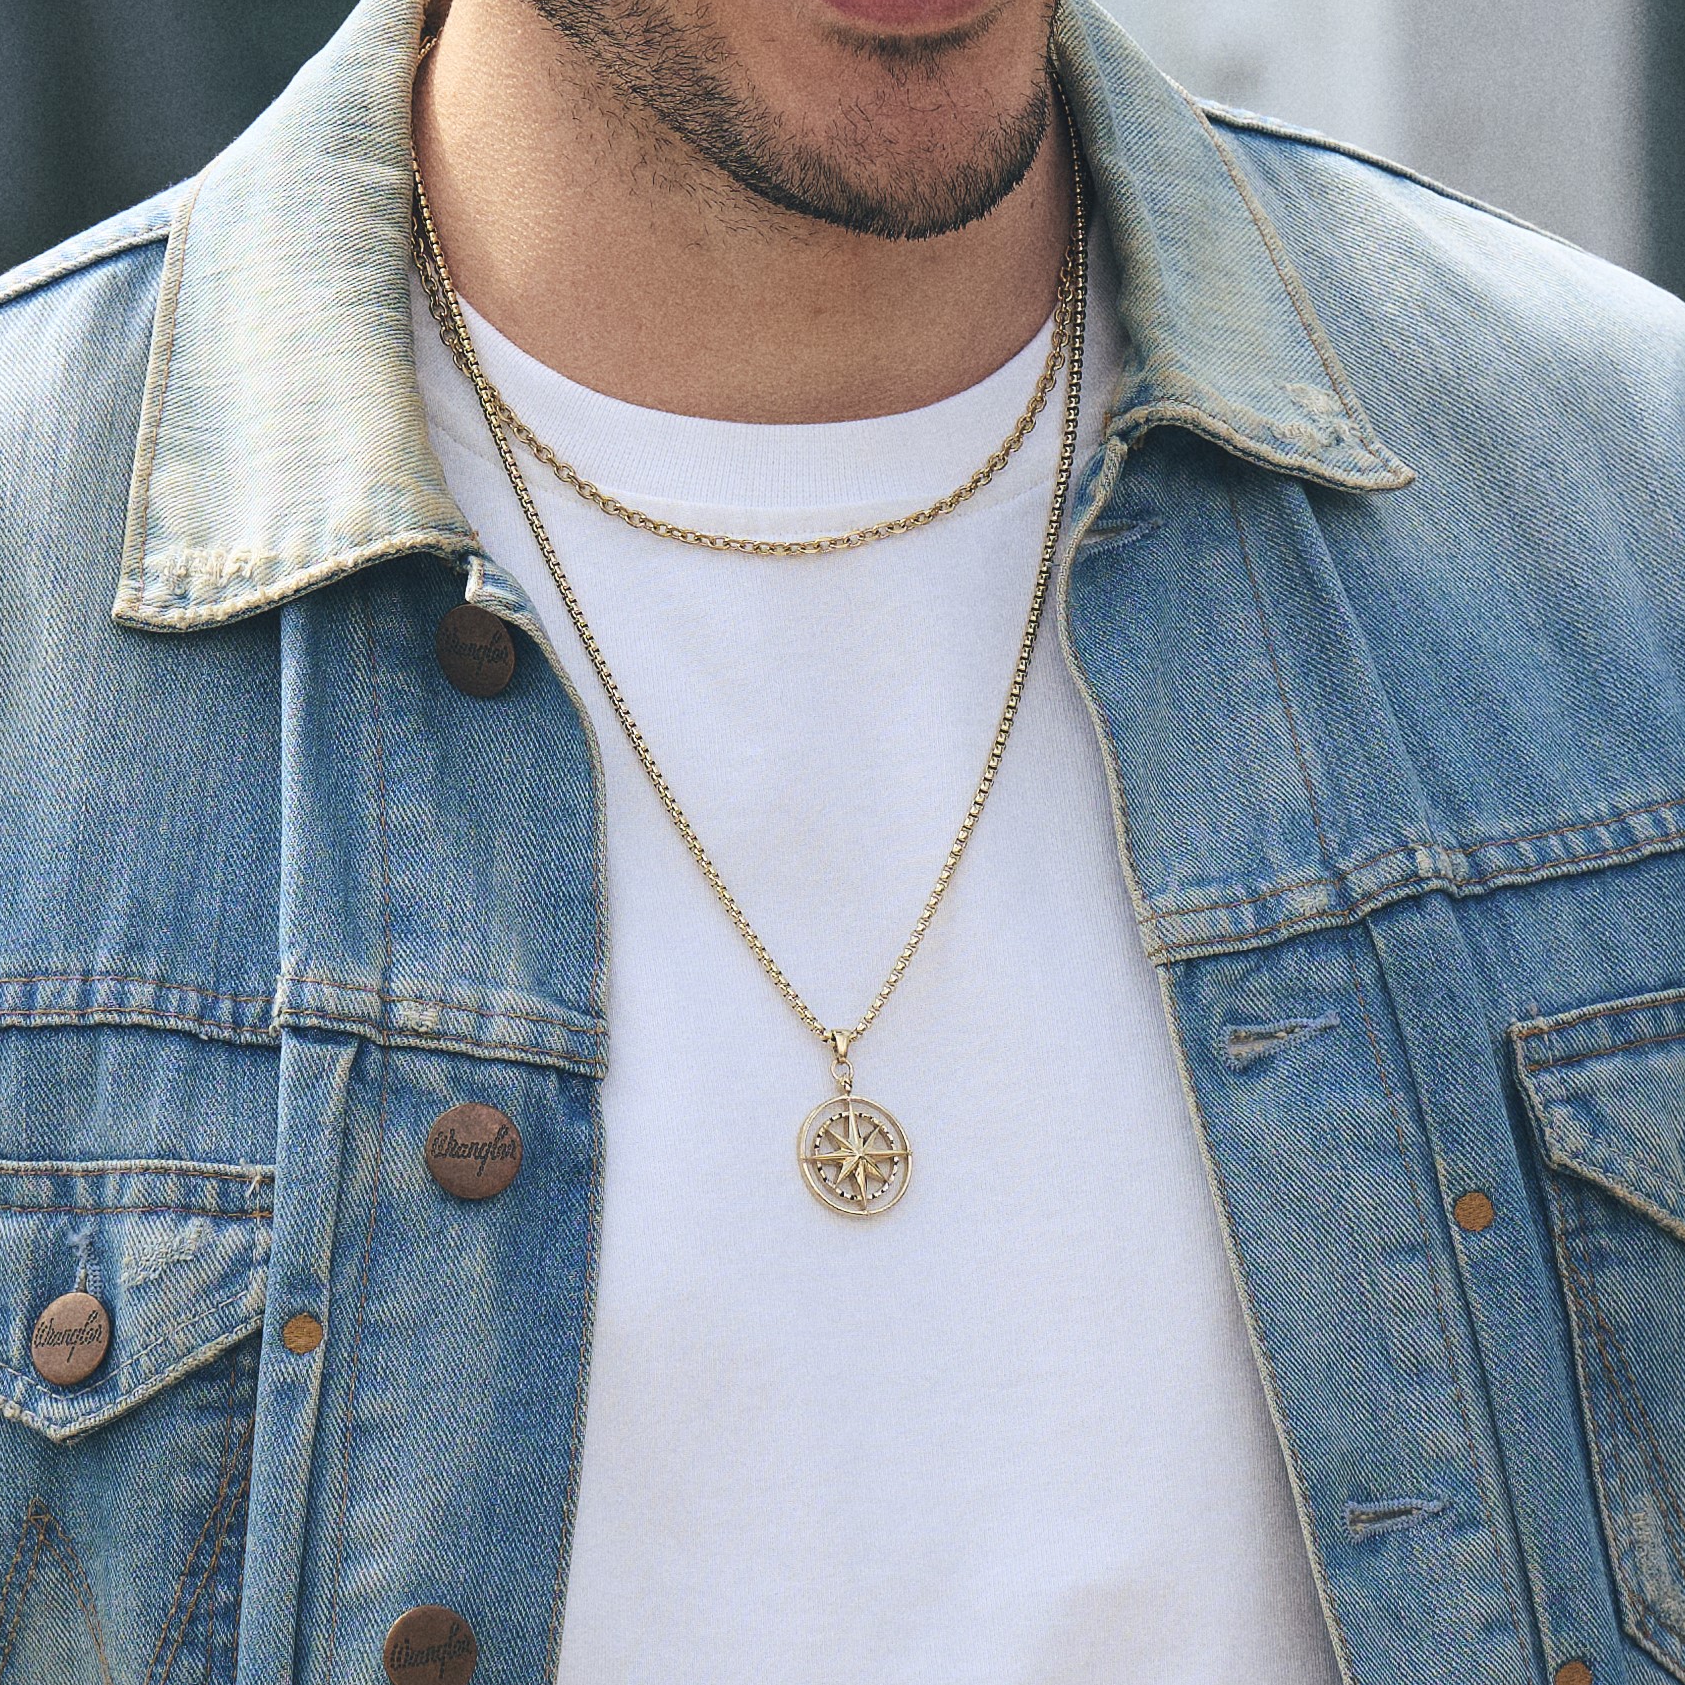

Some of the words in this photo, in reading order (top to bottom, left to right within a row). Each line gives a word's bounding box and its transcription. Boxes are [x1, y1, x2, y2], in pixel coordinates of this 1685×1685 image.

[431, 1123, 517, 1178] Wrangler
[33, 1309, 103, 1364] Wrangler
[390, 1621, 473, 1680] Wrangler
